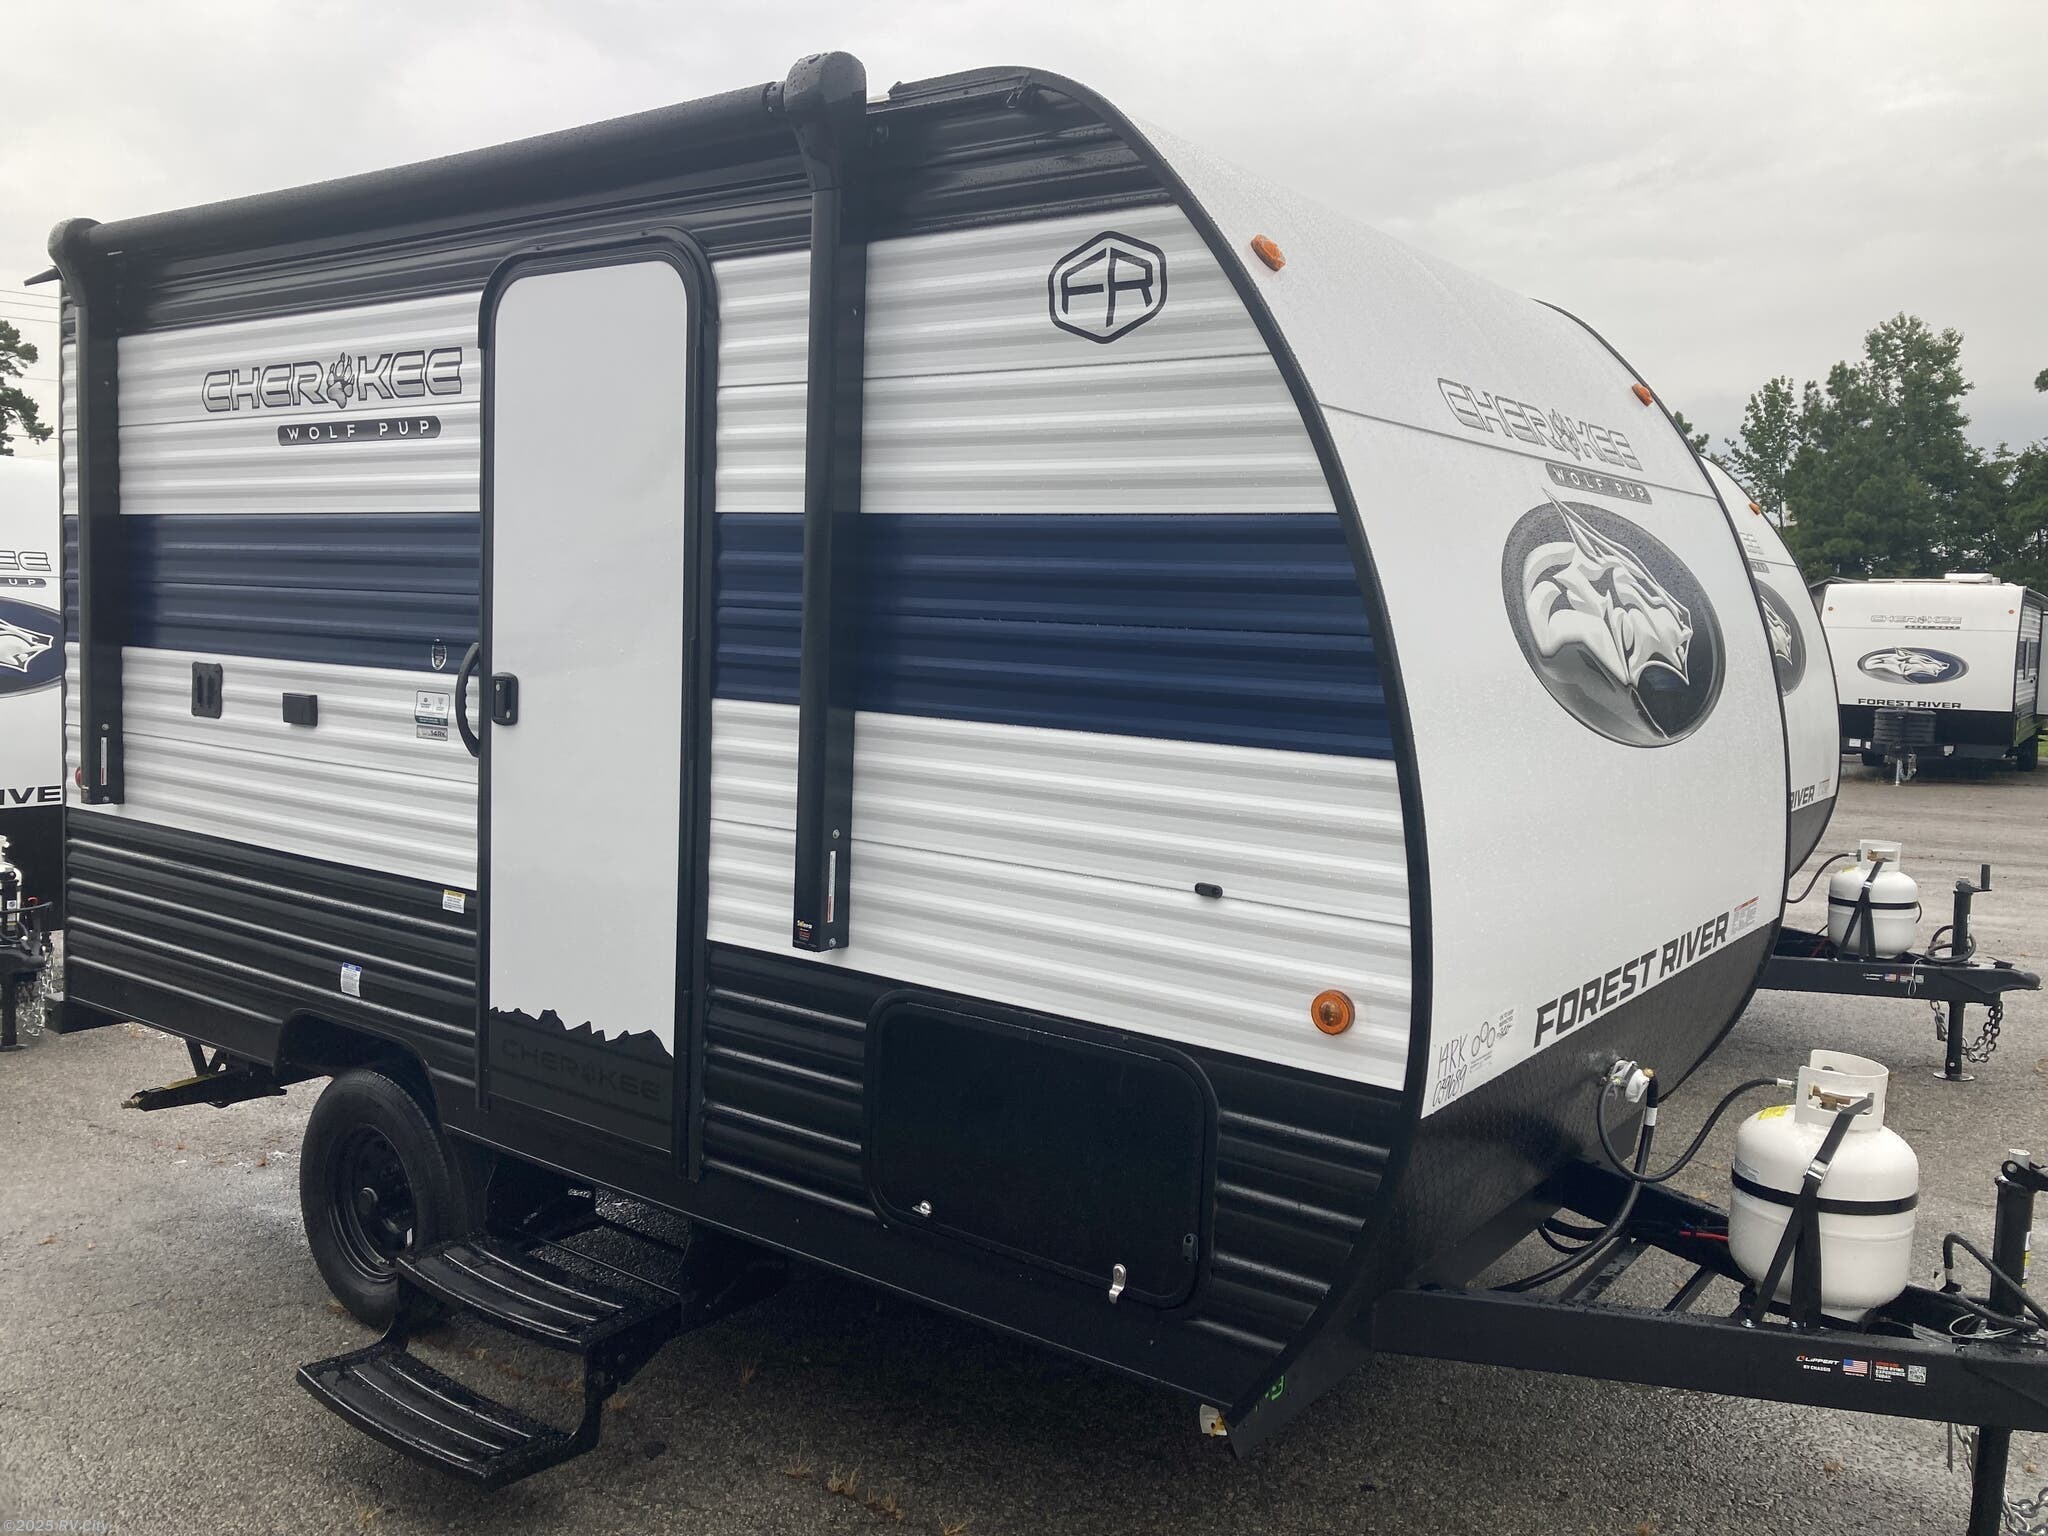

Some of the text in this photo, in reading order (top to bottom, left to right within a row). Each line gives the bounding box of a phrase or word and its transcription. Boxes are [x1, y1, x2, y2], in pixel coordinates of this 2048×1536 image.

[286, 421, 430, 440] WOLF PUP
[1553, 468, 1647, 500] WOLF PUP
[1858, 699, 1962, 709] FOREST RIVER
[1533, 948, 1657, 1048] FOREST
[1659, 911, 1730, 978] RIVER
